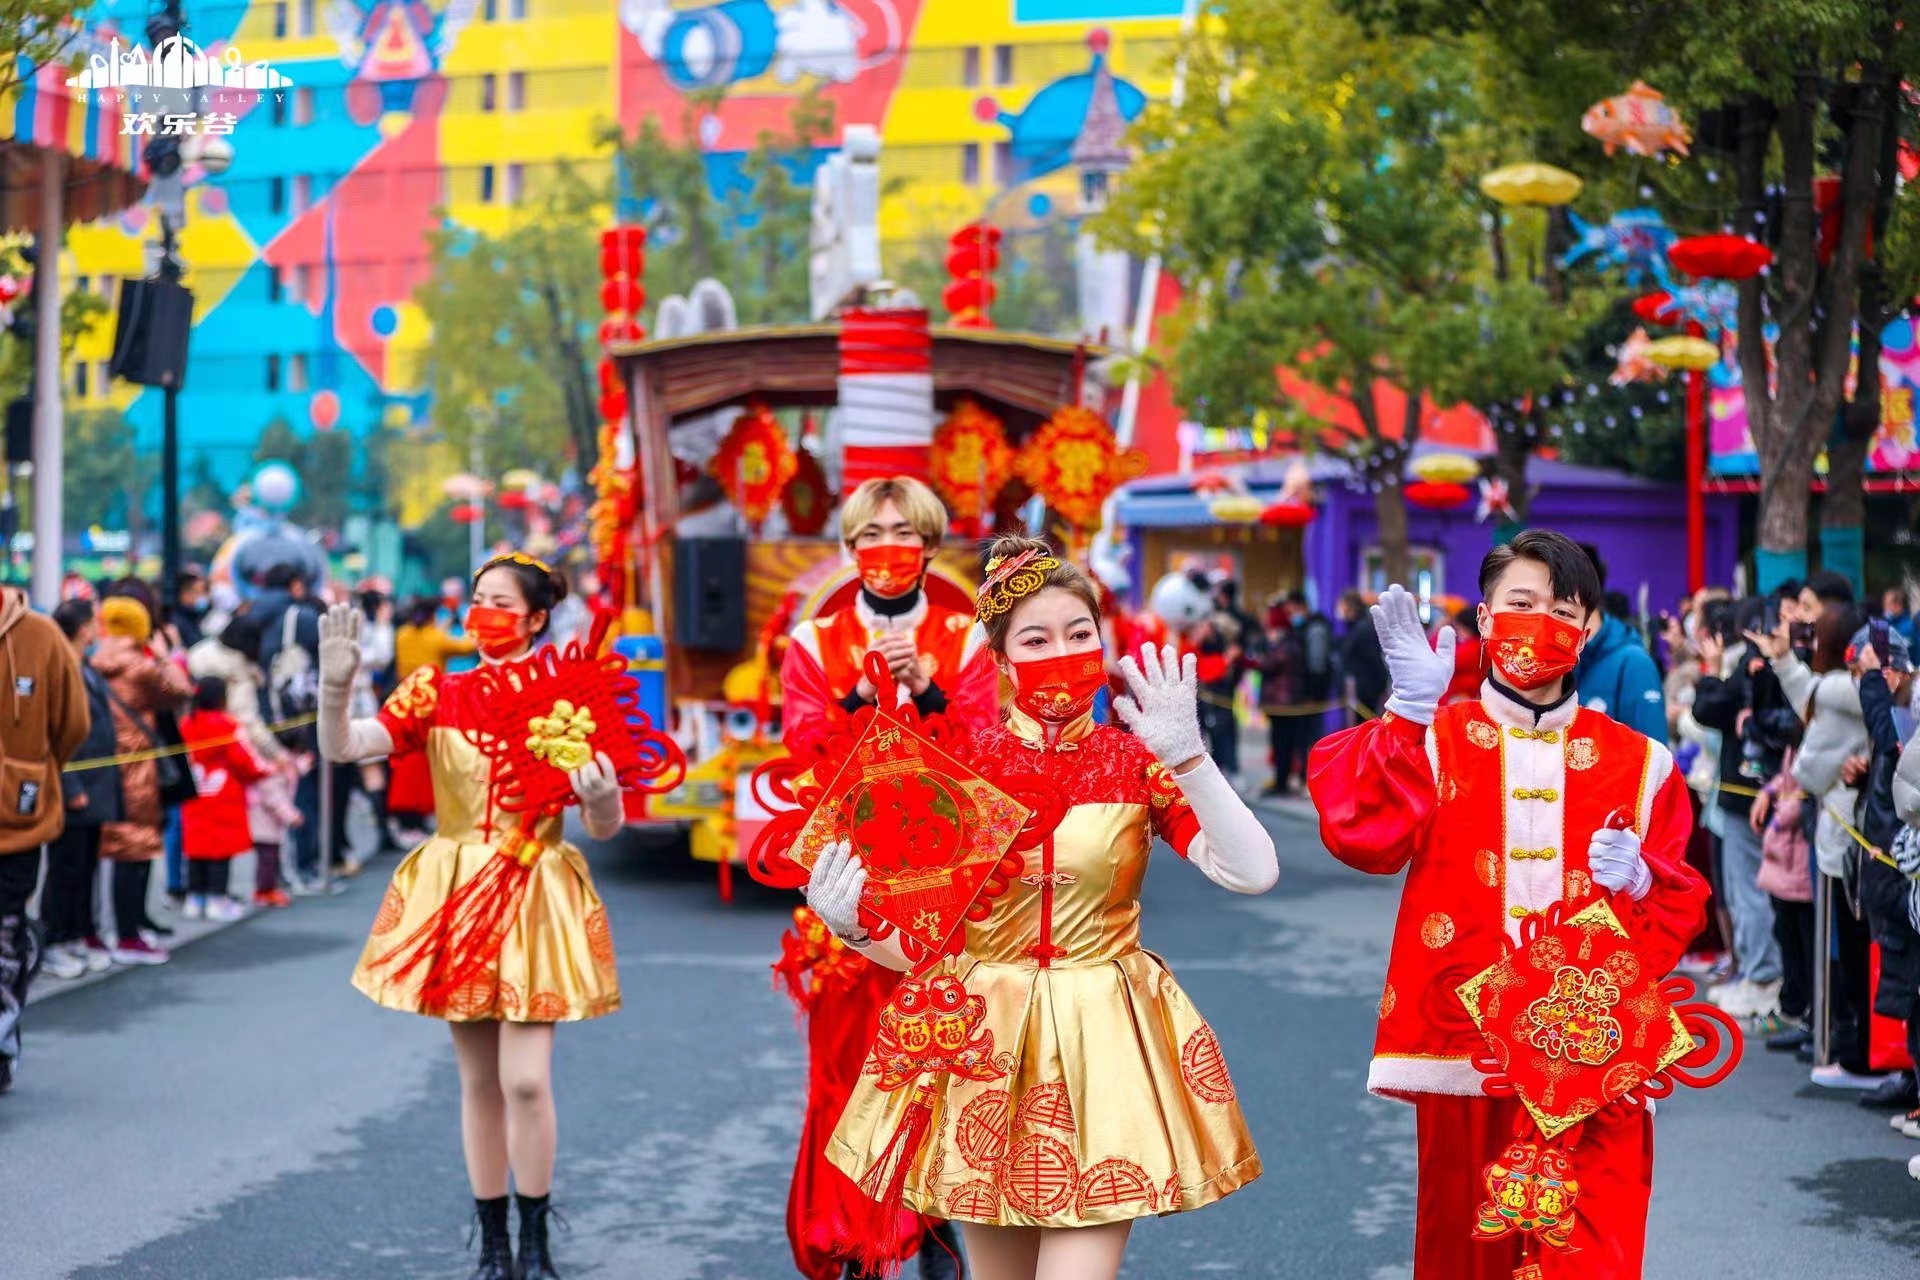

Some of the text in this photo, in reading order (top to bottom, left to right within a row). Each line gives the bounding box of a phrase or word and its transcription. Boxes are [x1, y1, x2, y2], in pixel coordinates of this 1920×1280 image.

[901, 1018, 963, 1048] 福 福
[1500, 1181, 1563, 1215] 福 福
